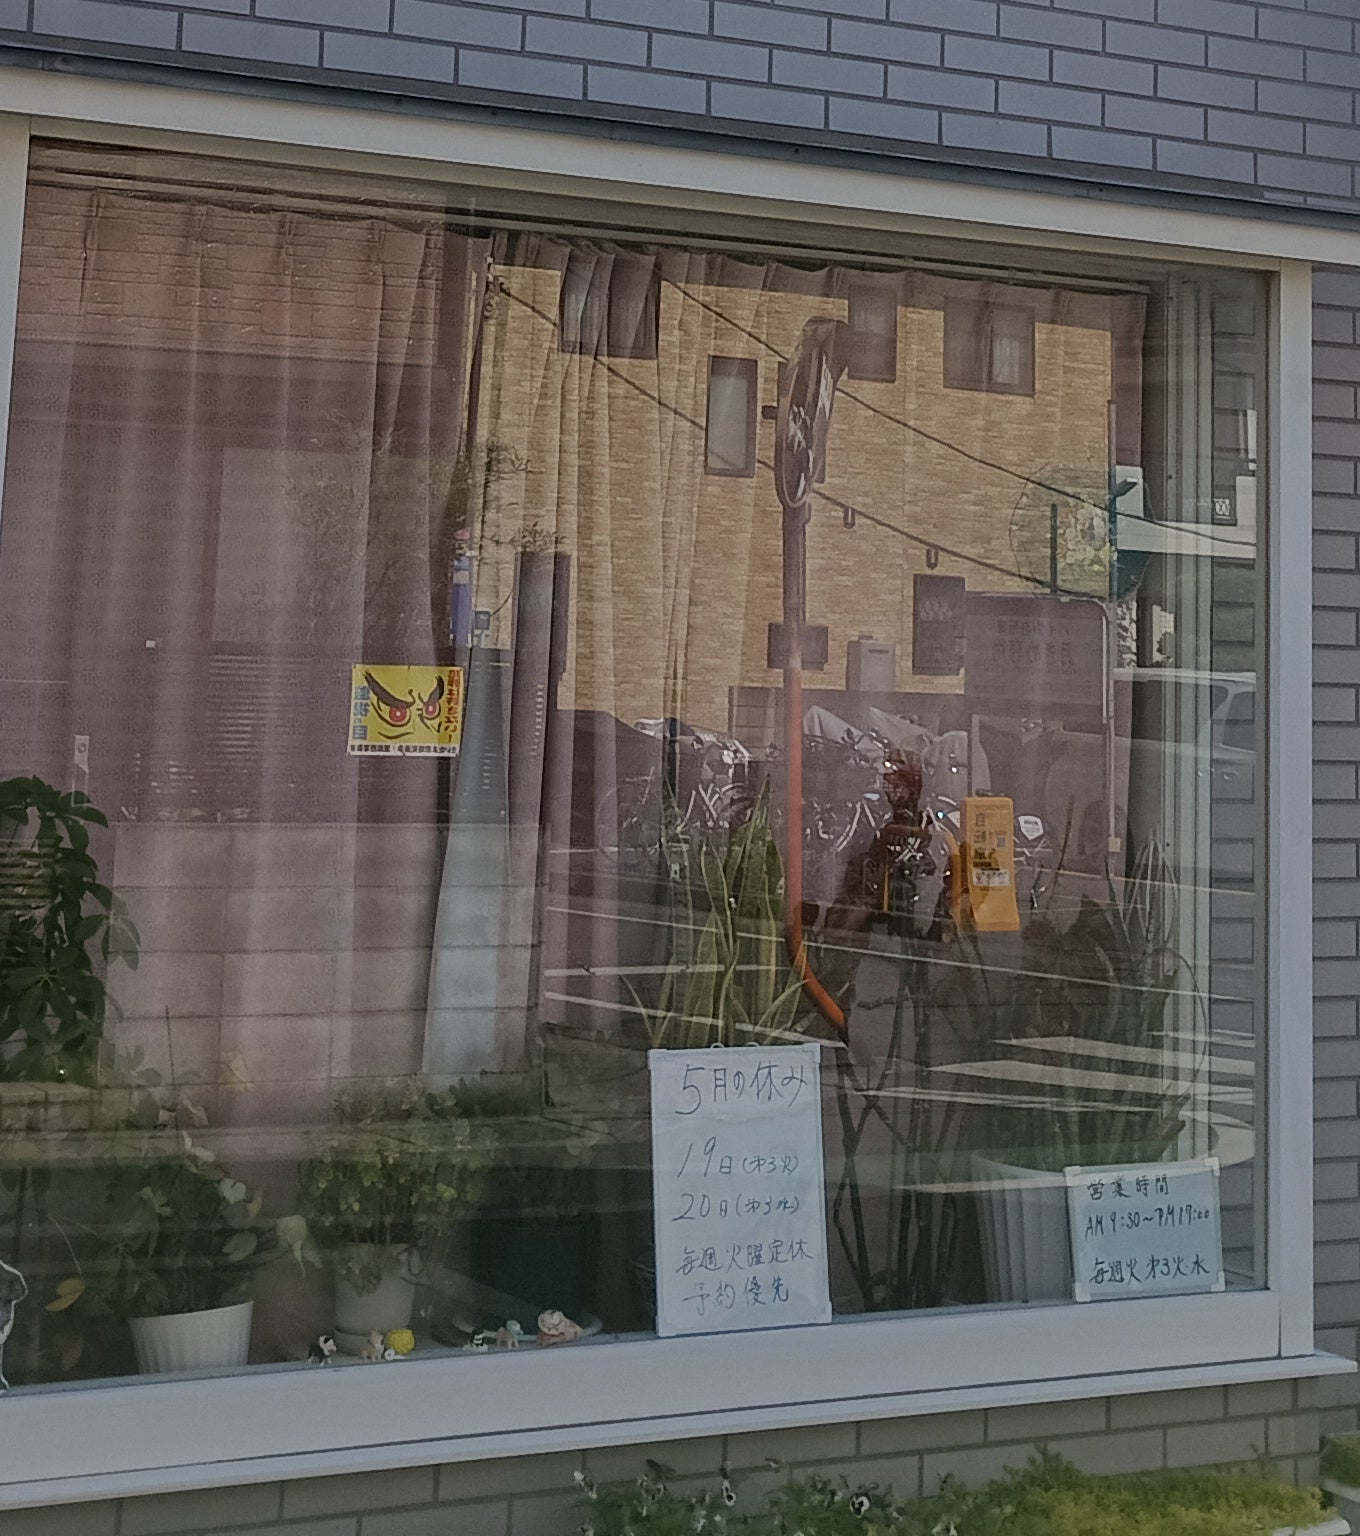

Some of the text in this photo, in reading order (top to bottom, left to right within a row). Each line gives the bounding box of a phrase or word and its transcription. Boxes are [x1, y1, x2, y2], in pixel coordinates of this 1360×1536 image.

[674, 1060, 809, 1115] 5月の休み
[1087, 1174, 1169, 1200] 営業時間
[682, 1276, 790, 1316] 予約優先
